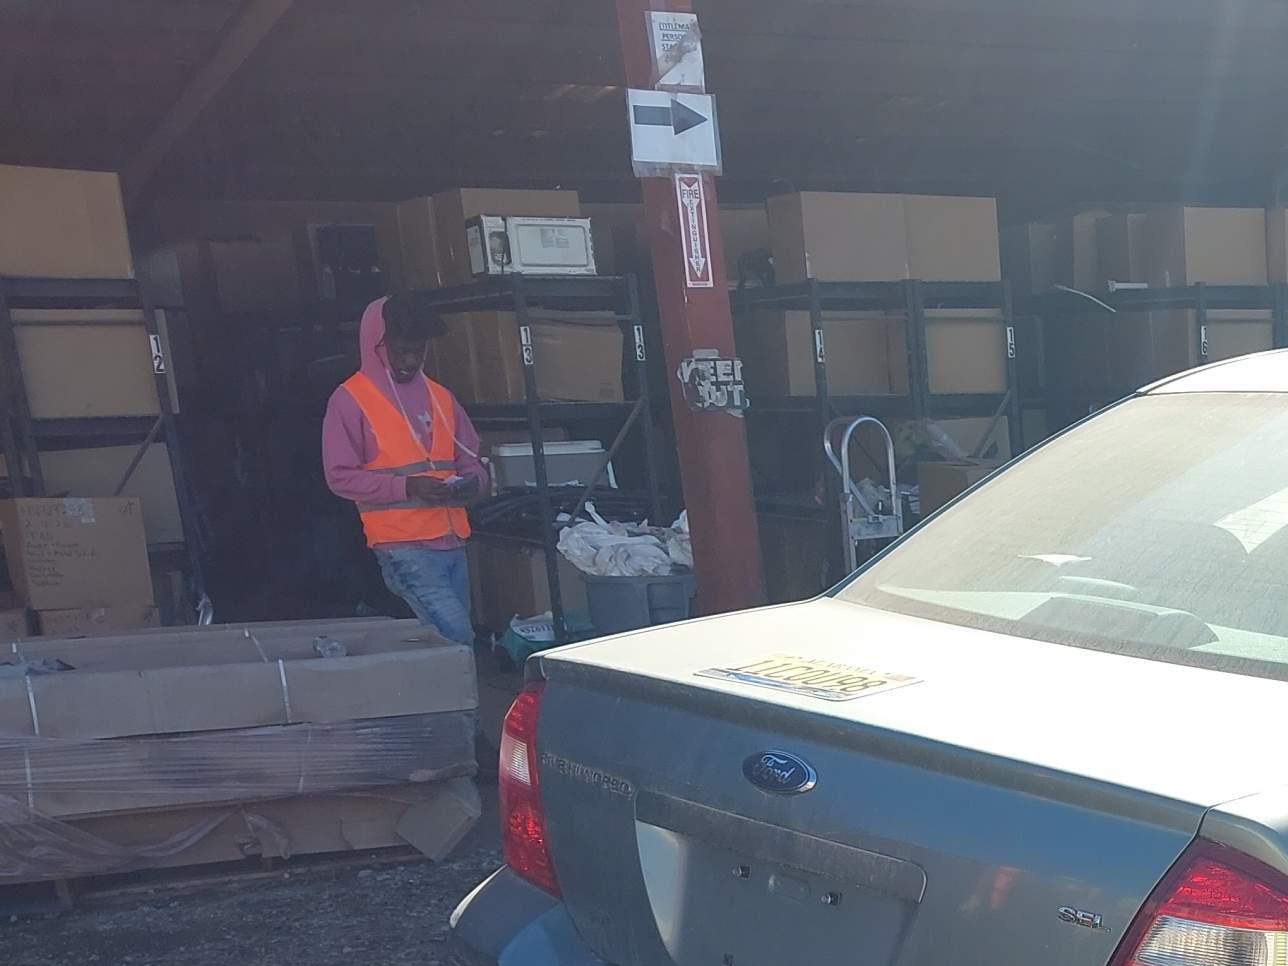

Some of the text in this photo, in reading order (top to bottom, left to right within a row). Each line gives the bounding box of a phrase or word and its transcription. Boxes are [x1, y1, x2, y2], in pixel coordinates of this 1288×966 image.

[681, 188, 700, 200] FIRE
[689, 200, 701, 272] EXTINGUISHER
[152, 336, 164, 372] 12
[522, 328, 533, 364] 13
[635, 327, 645, 360] 13
[760, 754, 796, 785] Ford
[1058, 905, 1111, 933] SEL
